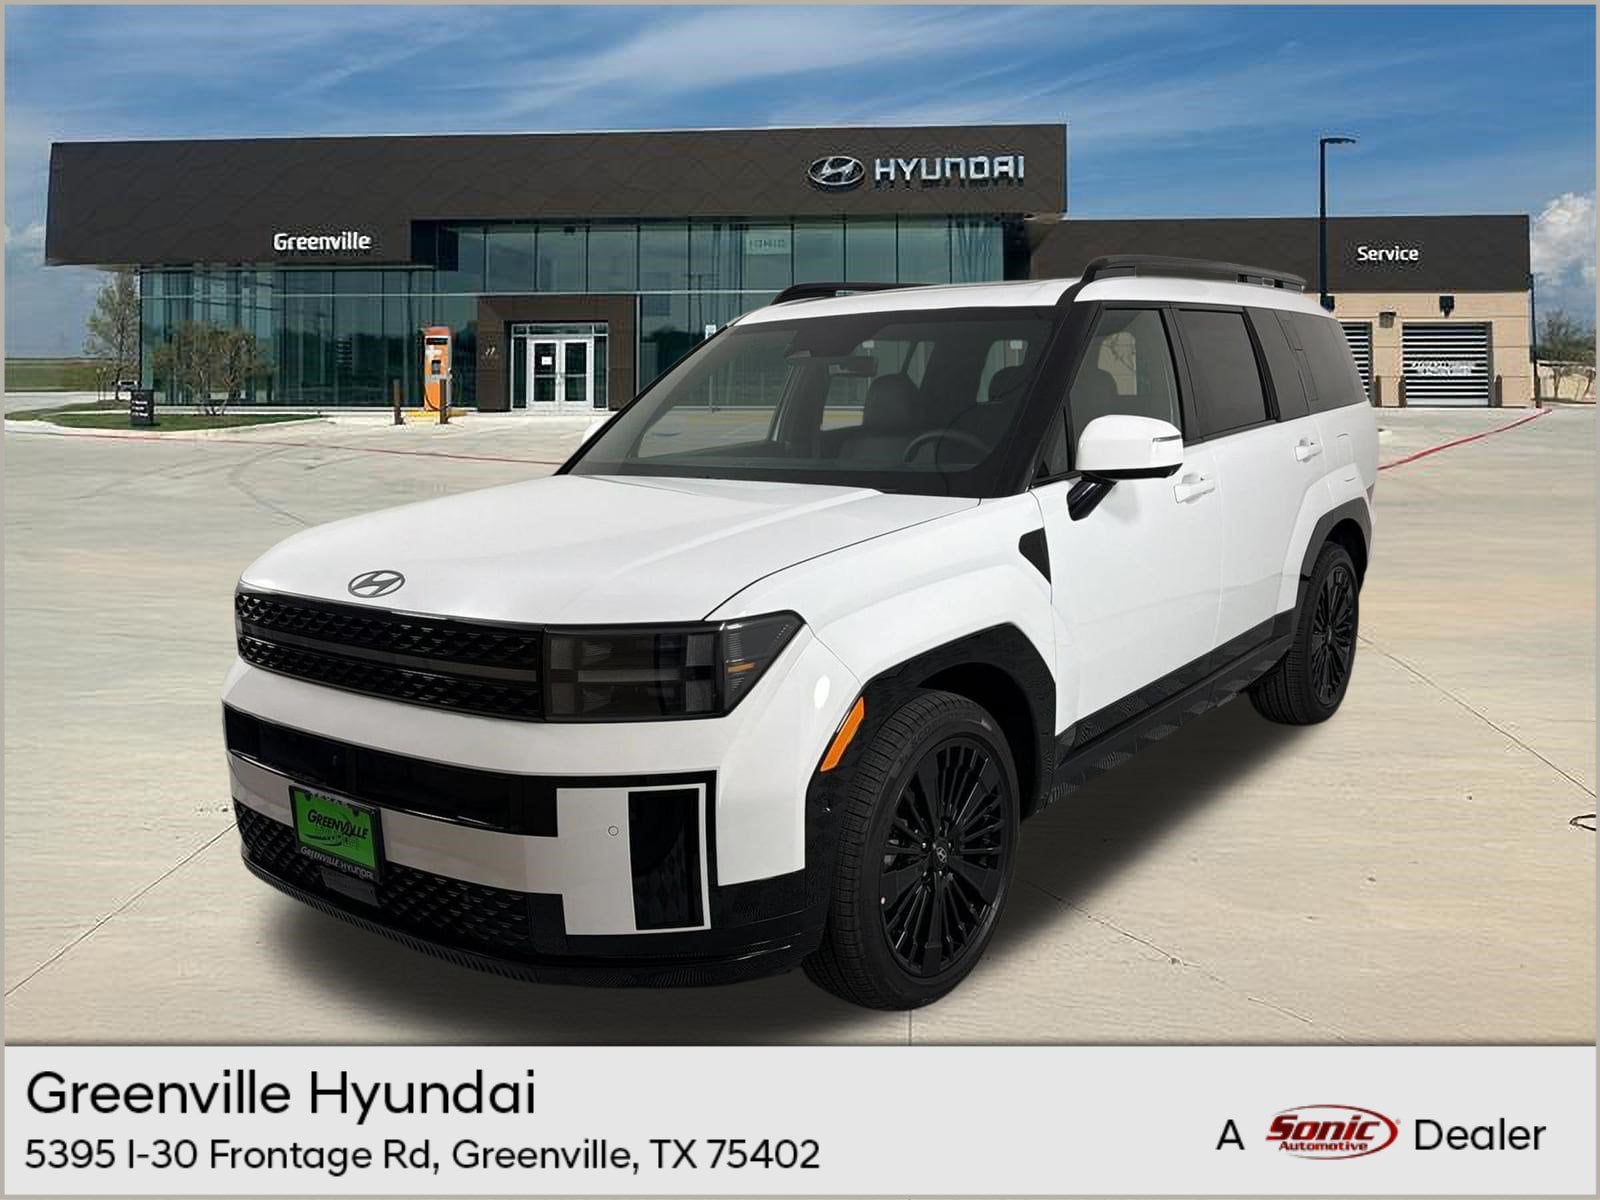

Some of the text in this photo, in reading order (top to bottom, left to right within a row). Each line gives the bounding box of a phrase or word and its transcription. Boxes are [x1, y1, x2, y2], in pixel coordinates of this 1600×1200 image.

[874, 155, 1025, 181] HYUNDAI
[273, 231, 372, 251] Greenville
[1356, 245, 1419, 261] Service
[307, 808, 369, 840] GREENVILLE
[300, 846, 340, 868] GREENVILLE
